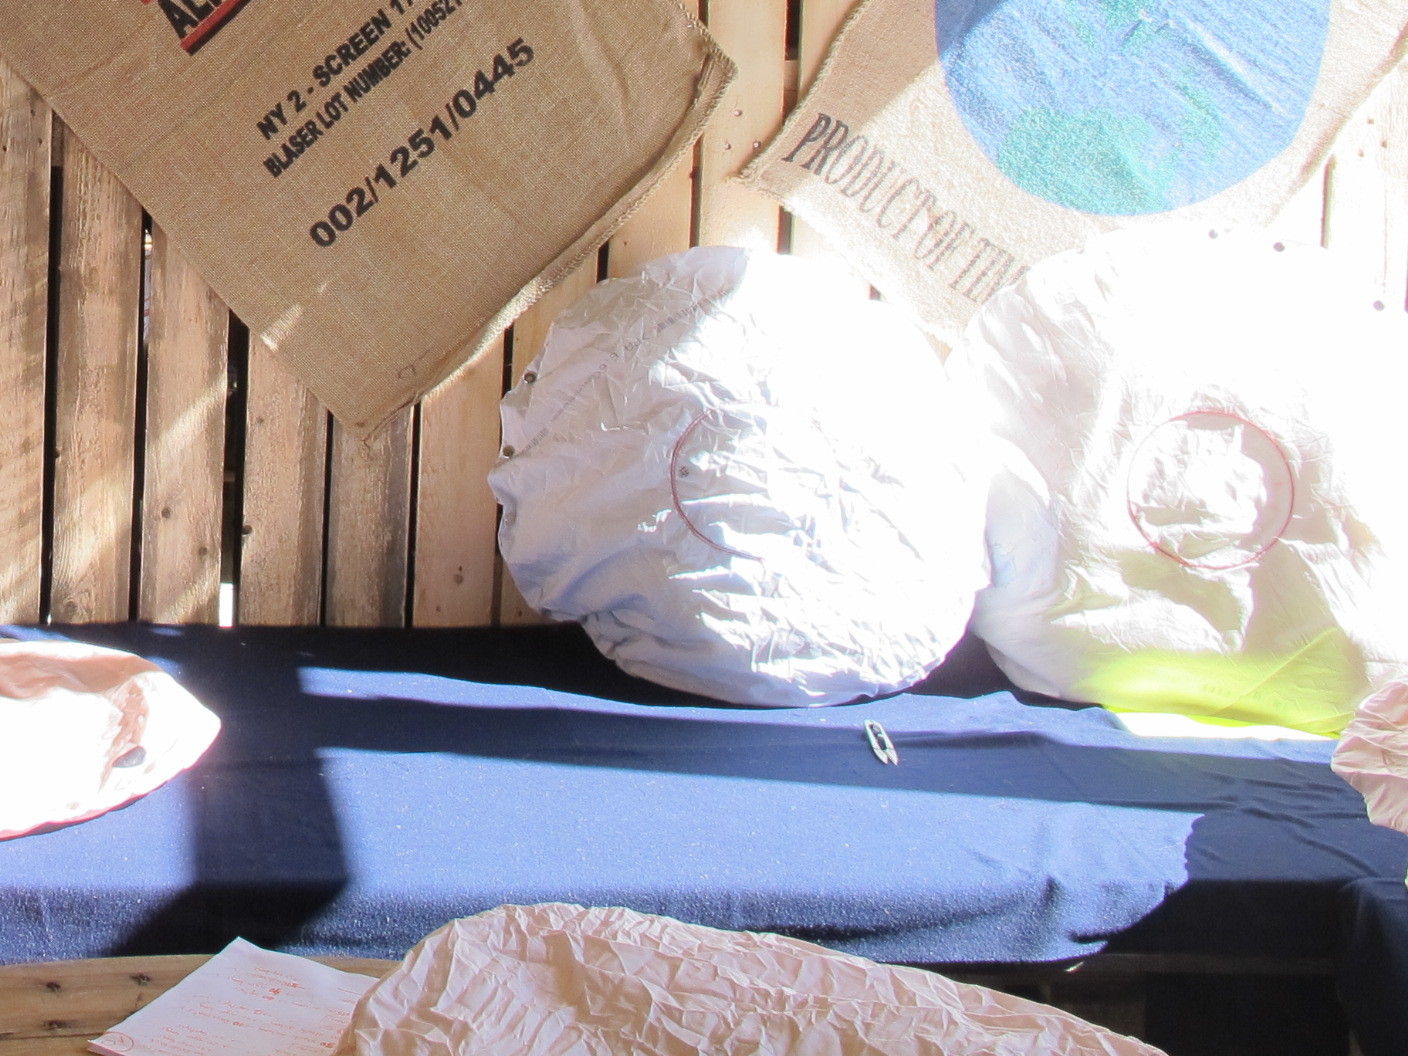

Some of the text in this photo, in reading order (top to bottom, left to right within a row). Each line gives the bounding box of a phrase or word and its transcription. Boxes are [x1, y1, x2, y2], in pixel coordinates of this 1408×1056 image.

[256, 102, 288, 140] NY
[287, 90, 307, 113] 2
[313, 8, 392, 87] SCREEN
[263, 120, 324, 178] BLASER
[316, 92, 349, 129] LOT
[309, 37, 534, 248] 002/1251/0445
[781, 112, 1030, 305] PRODUCT OF TIM
